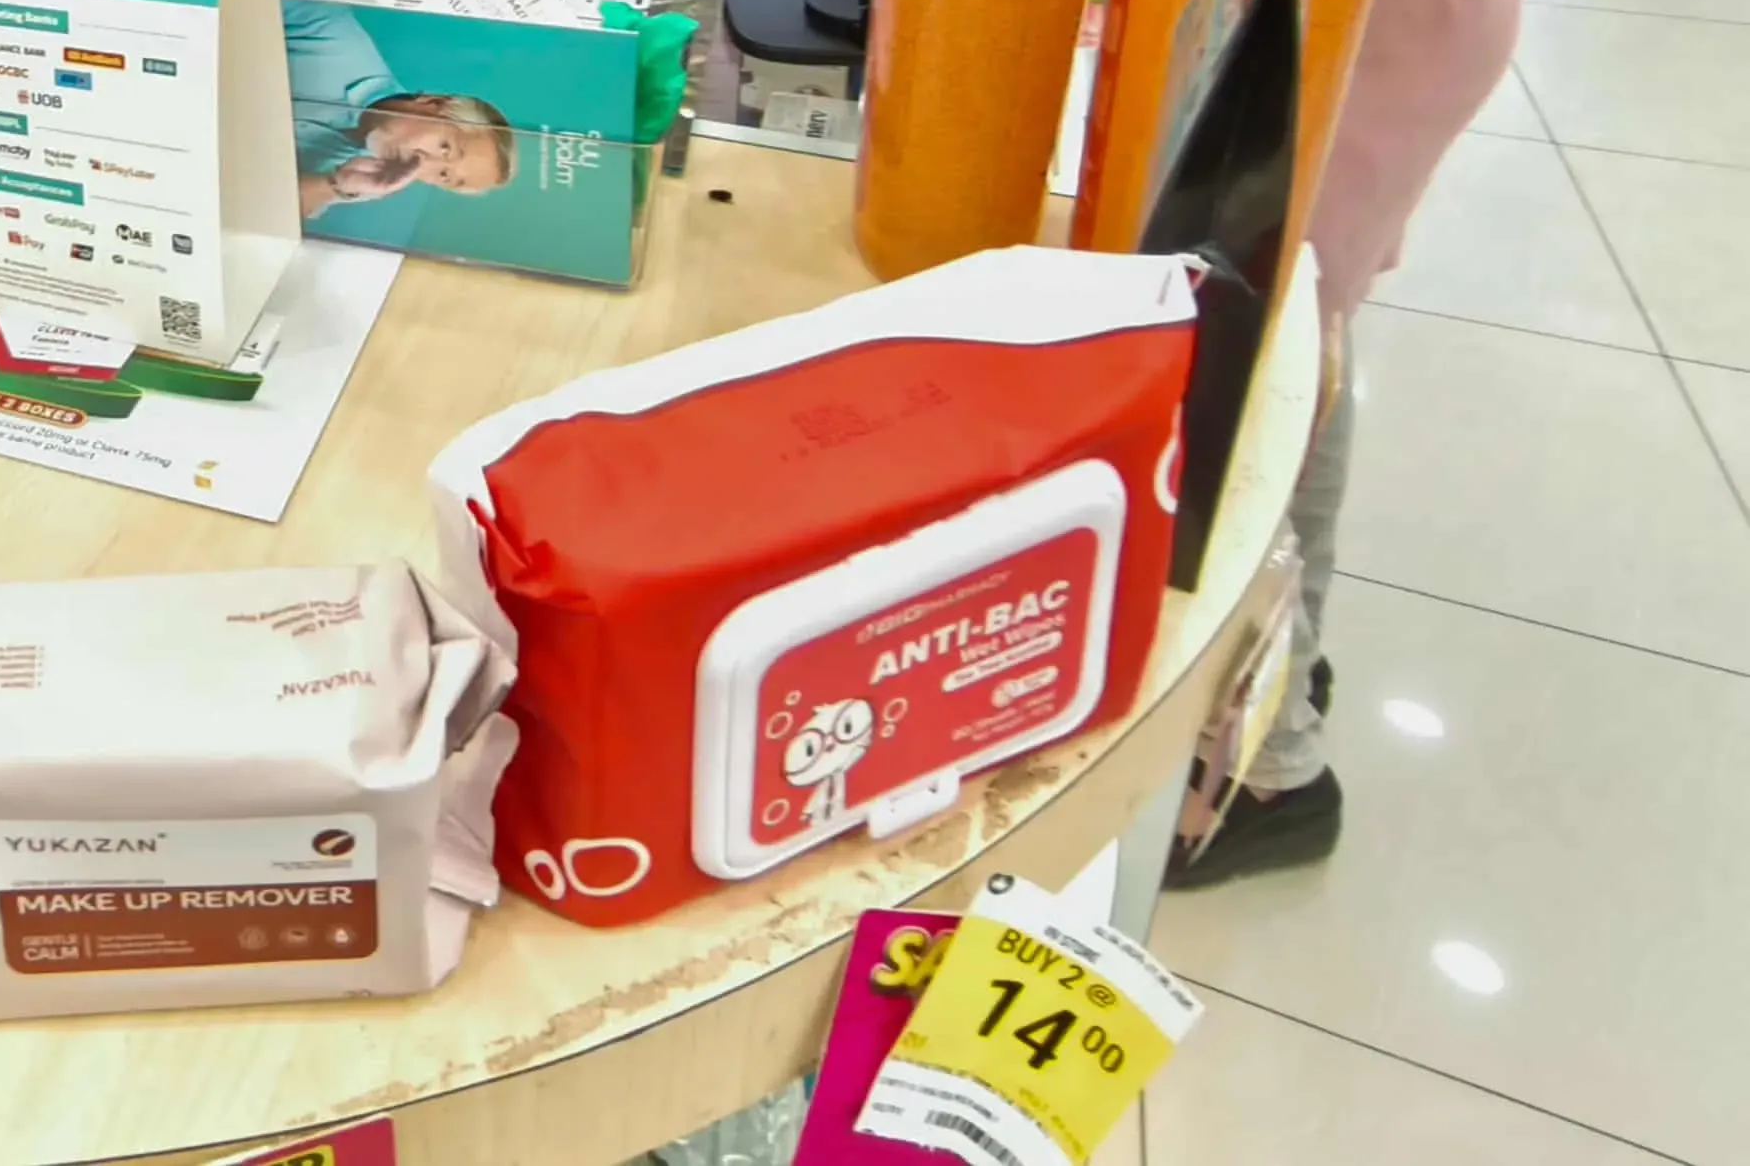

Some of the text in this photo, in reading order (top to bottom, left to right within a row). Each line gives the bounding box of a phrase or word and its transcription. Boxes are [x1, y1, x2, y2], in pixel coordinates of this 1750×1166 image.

[32, 92, 63, 109] UOB
[17, 400, 77, 423] BOXES
[870, 579, 1070, 685] ANTI-BAC
[281, 670, 377, 696] YUKAZAN
[4, 836, 158, 853] YUKAZAN
[16, 886, 354, 914] MAKE UP REMOVER
[22, 946, 79, 961] CALM
[996, 927, 1117, 1008] BUY 2 @
[977, 979, 1125, 1073] 14 00
